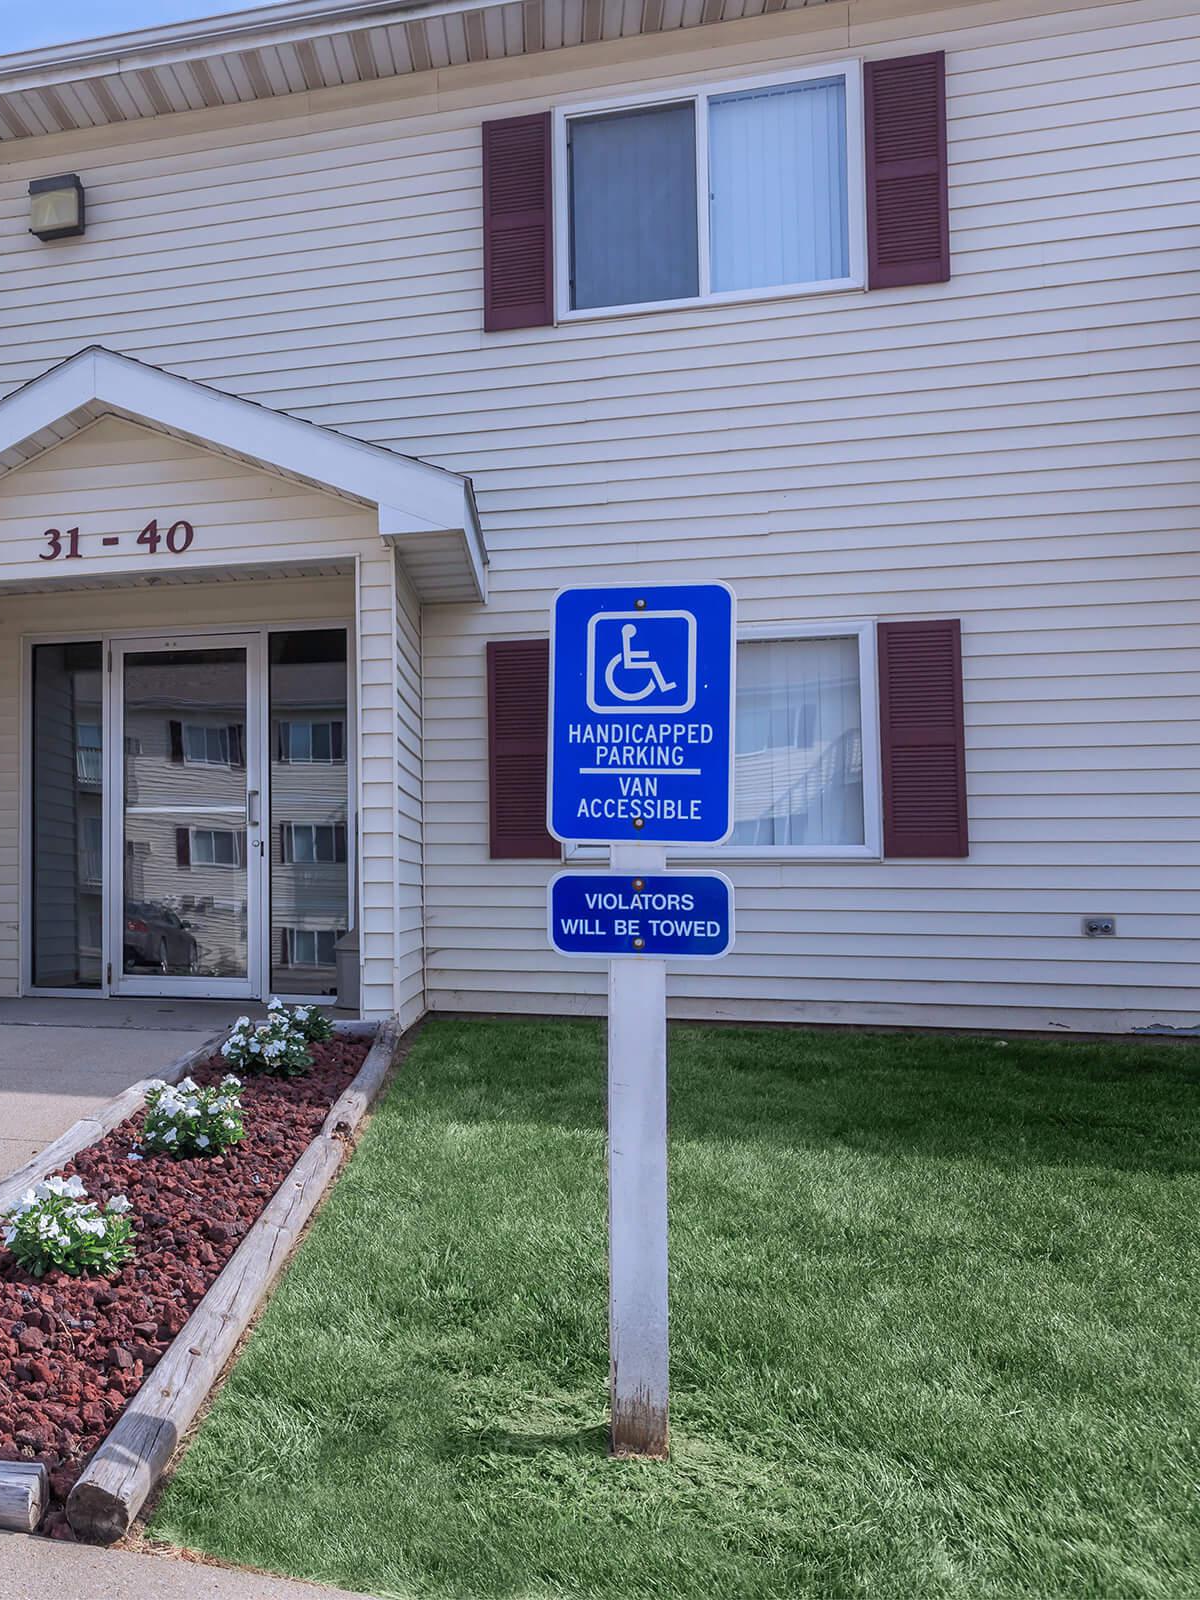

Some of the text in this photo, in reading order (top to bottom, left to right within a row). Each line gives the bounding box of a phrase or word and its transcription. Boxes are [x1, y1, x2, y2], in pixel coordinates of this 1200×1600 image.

[38, 526, 83, 561] 31
[136, 519, 195, 555] 40
[569, 724, 713, 744] HANDICAPPED
[596, 746, 684, 766] PARKING
[619, 777, 657, 797] VAN
[576, 797, 703, 820] ACCESSIBLE
[584, 892, 695, 911] VIOLATORS
[560, 918, 721, 938] WILL BE TOWED
